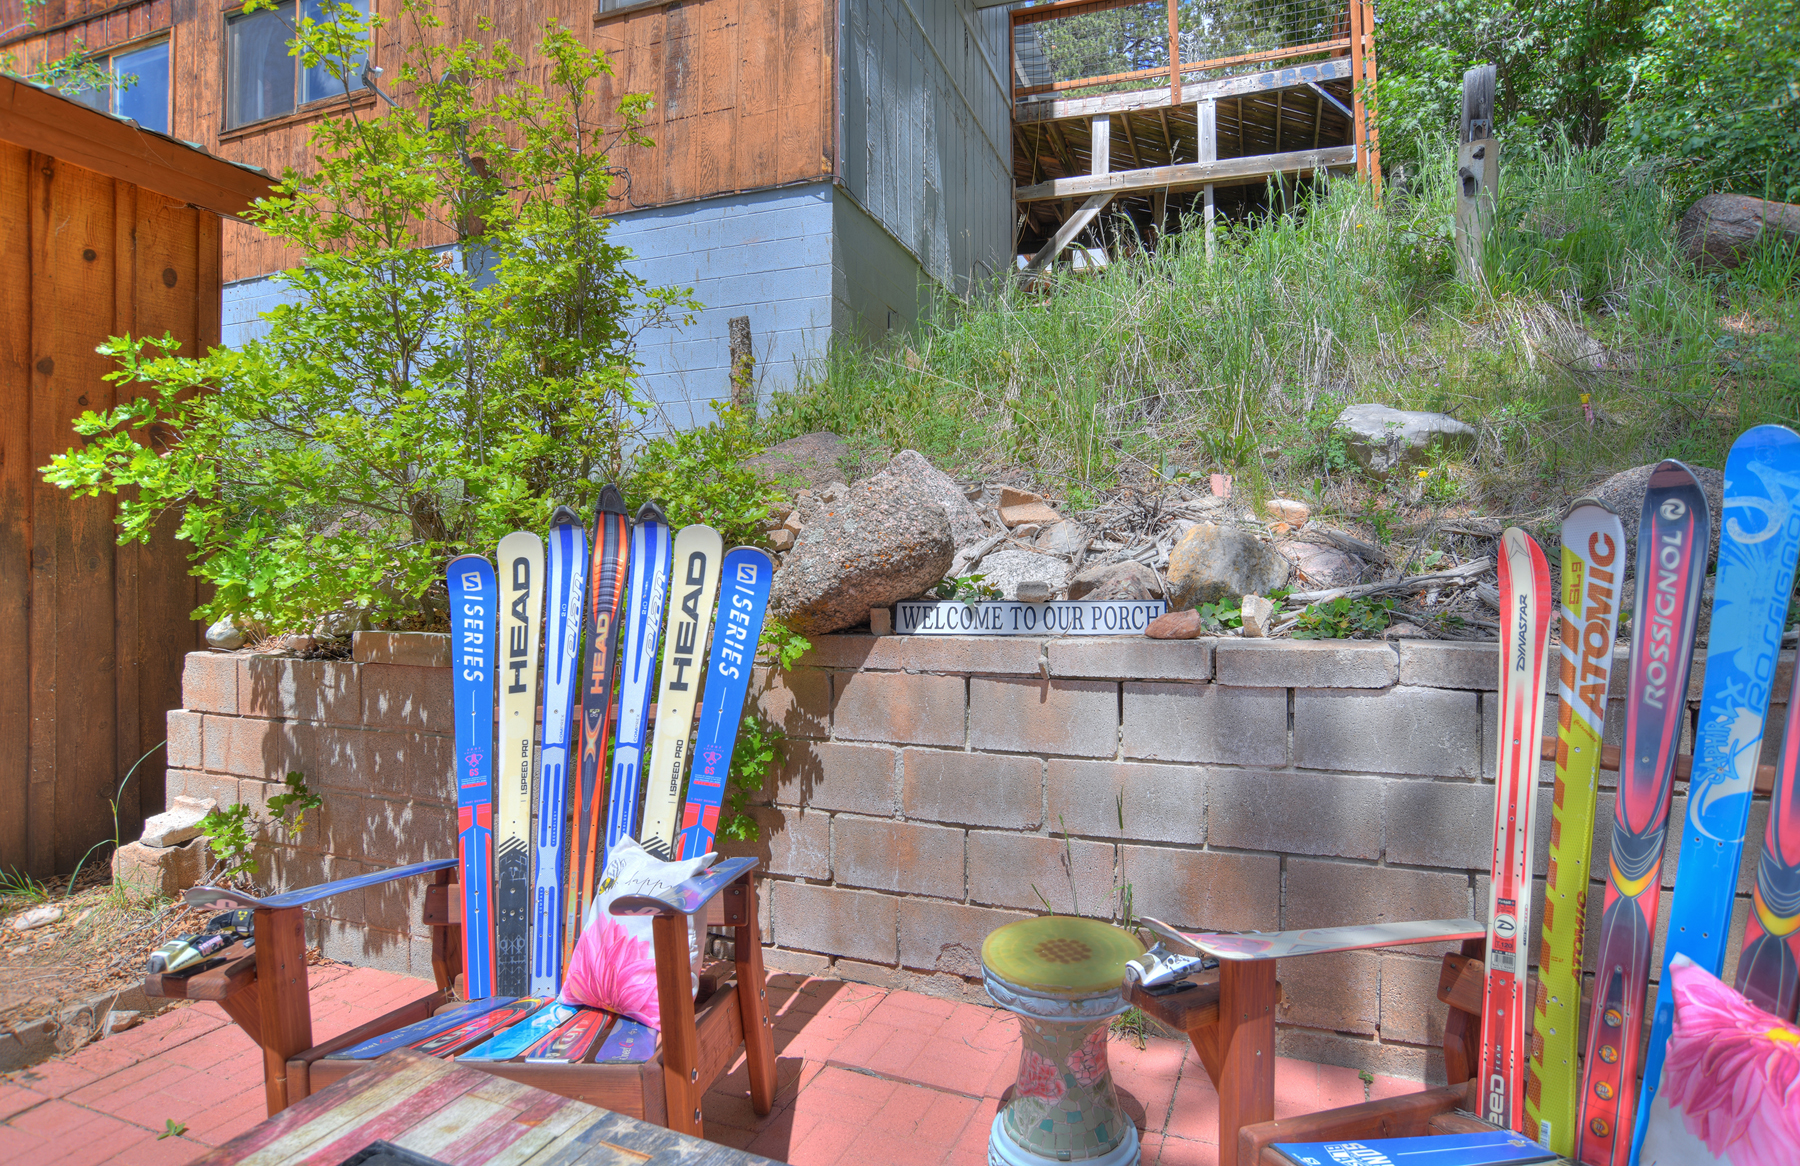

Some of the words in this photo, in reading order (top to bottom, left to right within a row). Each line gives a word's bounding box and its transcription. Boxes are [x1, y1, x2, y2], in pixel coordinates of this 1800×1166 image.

[508, 557, 531, 694] HEAD
[566, 572, 584, 659] elan
[590, 612, 610, 694] HEAD
[645, 570, 666, 658] elan
[669, 551, 707, 691] HEAD
[902, 605, 1003, 630] WELCOME
[1010, 605, 1037, 630] TO
[1043, 605, 1084, 630] OUR
[1091, 605, 1160, 630] PORCH
[1516, 594, 1528, 672] DYNASTAR
[1578, 531, 1616, 722] ATOMIC
[1643, 530, 1682, 710] ROSSIGNOL
[469, 768, 479, 777] GS
[521, 739, 529, 758] PRO
[675, 739, 684, 758] PRO
[704, 766, 715, 775] GS
[1572, 891, 1587, 987] ATOMIC
